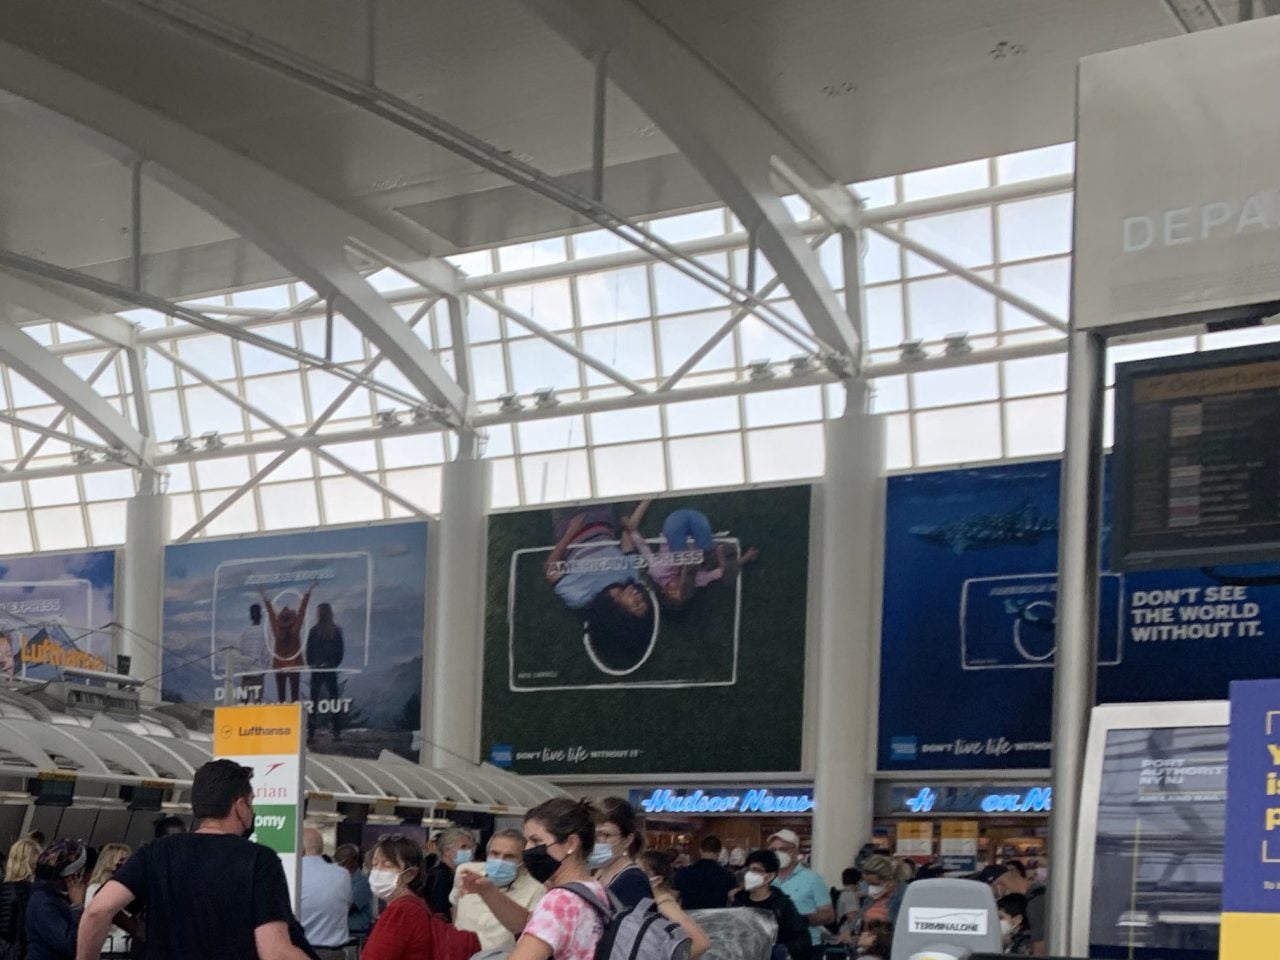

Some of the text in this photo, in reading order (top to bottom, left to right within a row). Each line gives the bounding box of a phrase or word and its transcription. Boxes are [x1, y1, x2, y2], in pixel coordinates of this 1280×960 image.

[1122, 194, 1280, 253] DEPA
[1132, 586, 1247, 606] DON'T SEE
[1132, 603, 1260, 624] THE WORLD
[1132, 621, 1265, 642] WITHOUT IT.
[21, 634, 106, 671] Lufthansa
[214, 685, 262, 700] DN'T
[319, 699, 351, 713] OUT
[239, 727, 290, 737] Lufthansa
[1140, 766, 1228, 776] AUTHORIT
[642, 789, 815, 812] Hudson News
